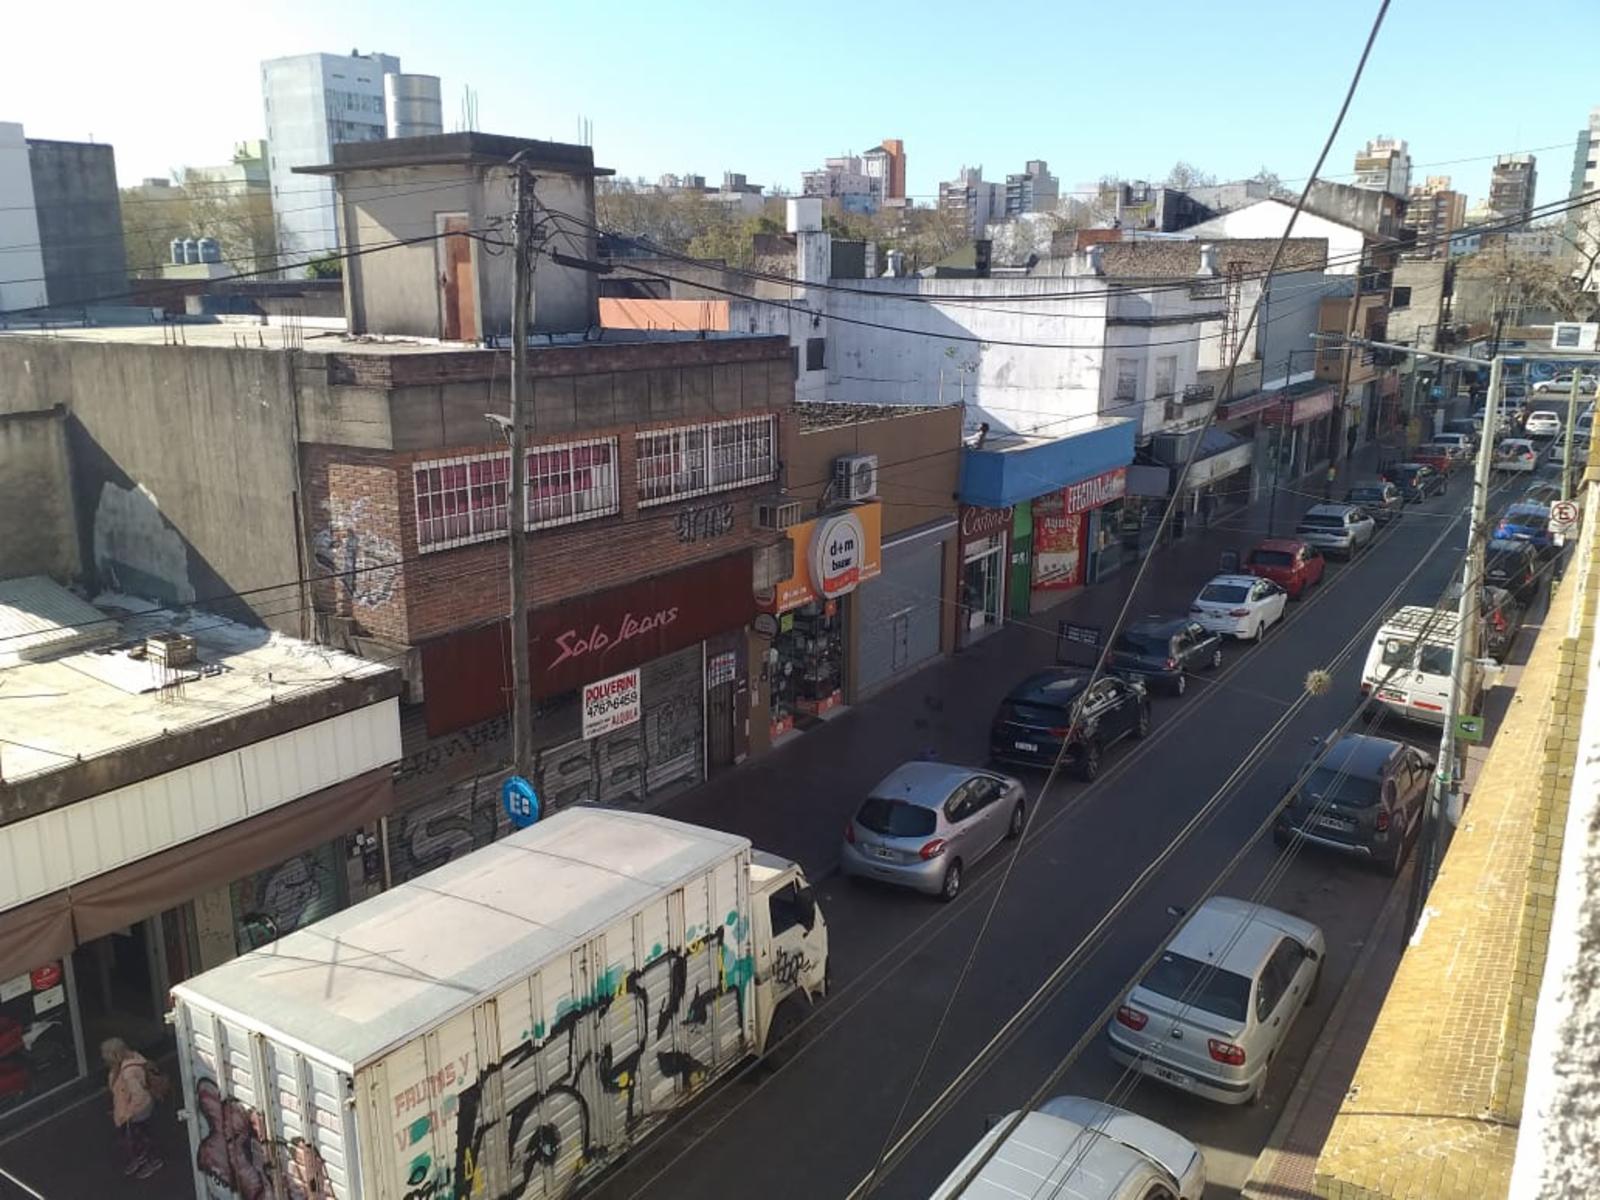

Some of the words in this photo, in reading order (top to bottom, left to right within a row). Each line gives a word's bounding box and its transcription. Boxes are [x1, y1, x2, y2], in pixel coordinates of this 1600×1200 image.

[547, 624, 609, 671] Solo
[603, 607, 678, 655] Jeans
[586, 673, 637, 702] POLVERINI
